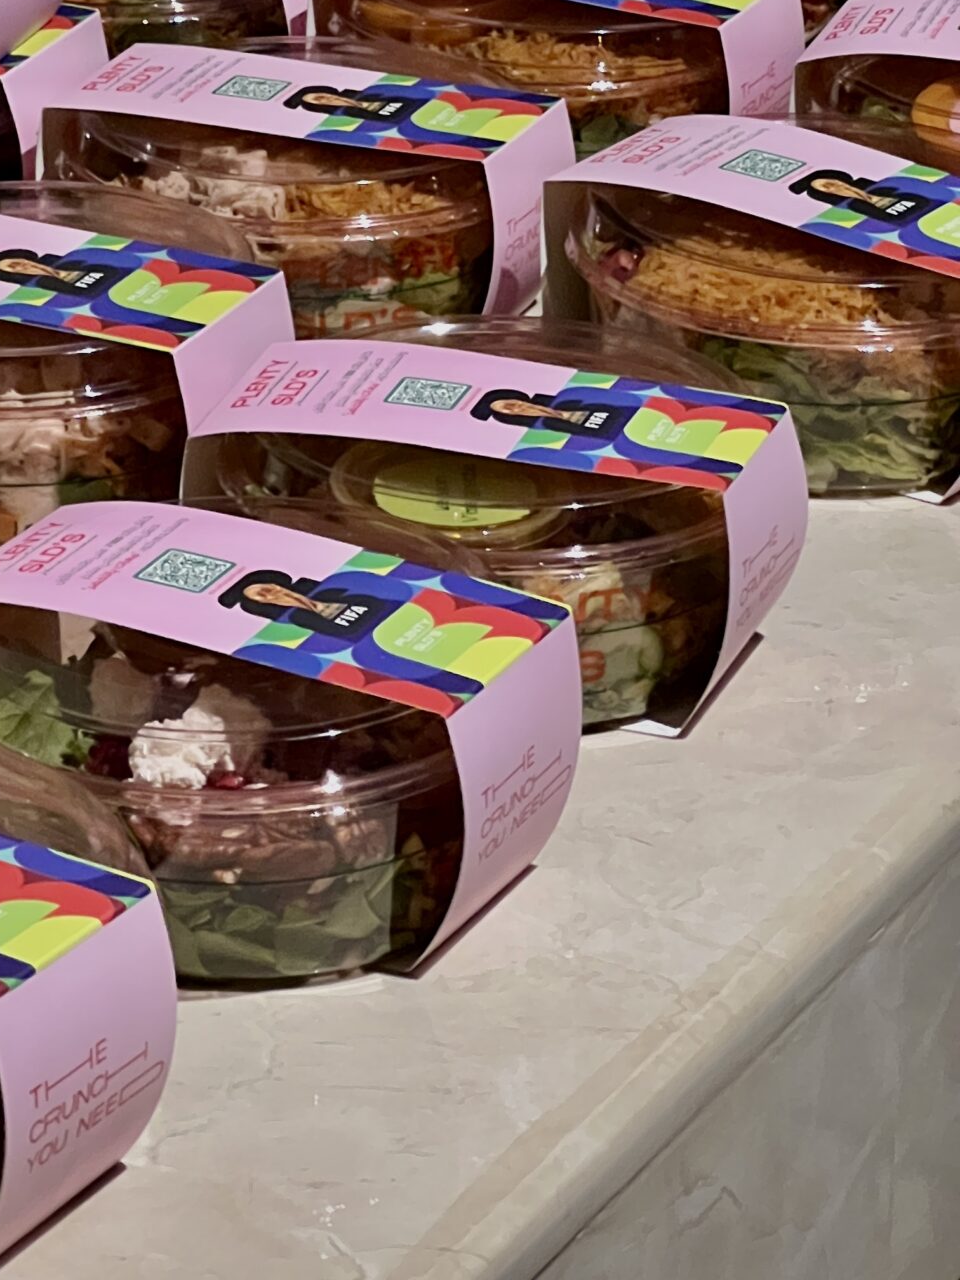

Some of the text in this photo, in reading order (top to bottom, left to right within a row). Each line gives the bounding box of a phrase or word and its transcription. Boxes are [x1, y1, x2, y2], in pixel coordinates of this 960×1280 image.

[334, 604, 369, 628] FIFA
[481, 744, 536, 809] THE
[29, 1037, 108, 1109] THE
[29, 1040, 149, 1144] CRUNCH
[27, 1059, 165, 1174] YOU NEED
